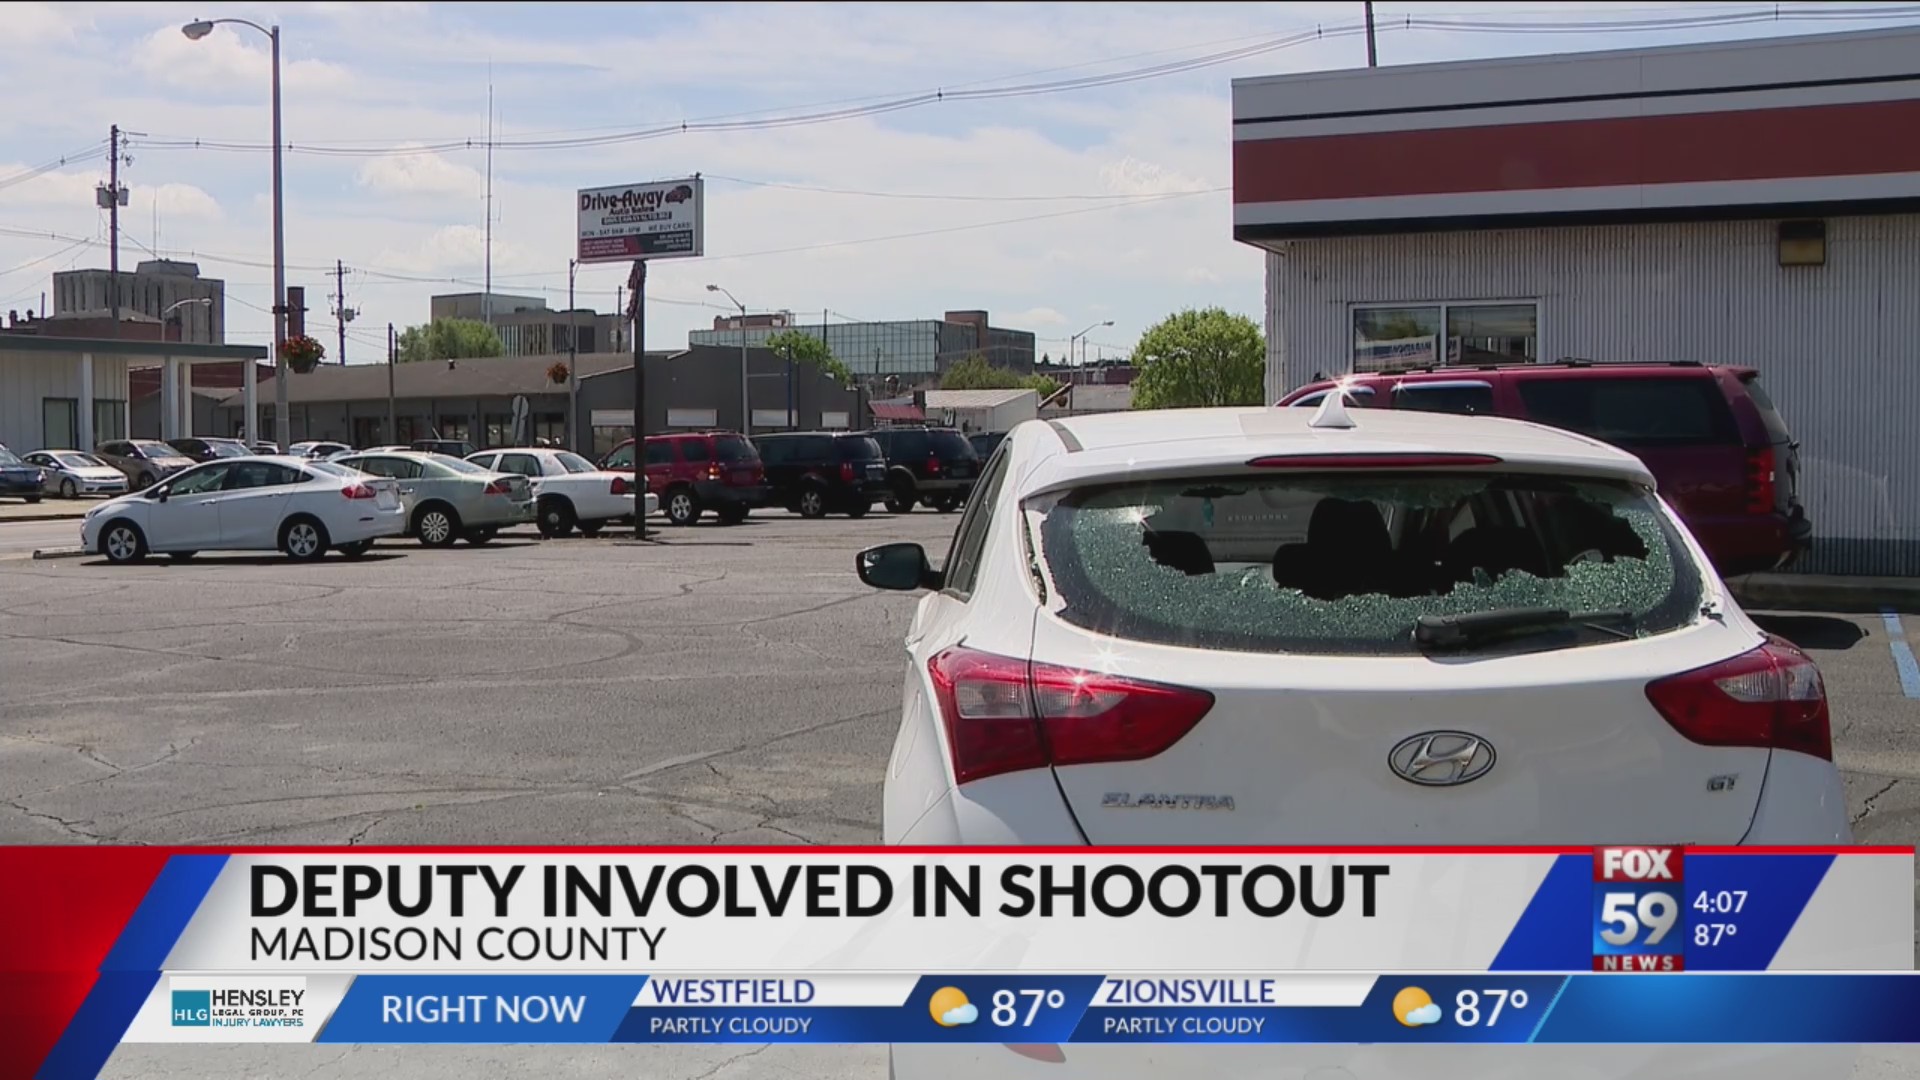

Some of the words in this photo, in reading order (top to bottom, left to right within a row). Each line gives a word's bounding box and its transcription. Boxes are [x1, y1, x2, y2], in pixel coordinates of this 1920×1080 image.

[581, 190, 664, 211] Drive-Away
[609, 208, 630, 216] Auto
[1707, 773, 1739, 792] GT
[1101, 792, 1236, 811] ELANTRA
